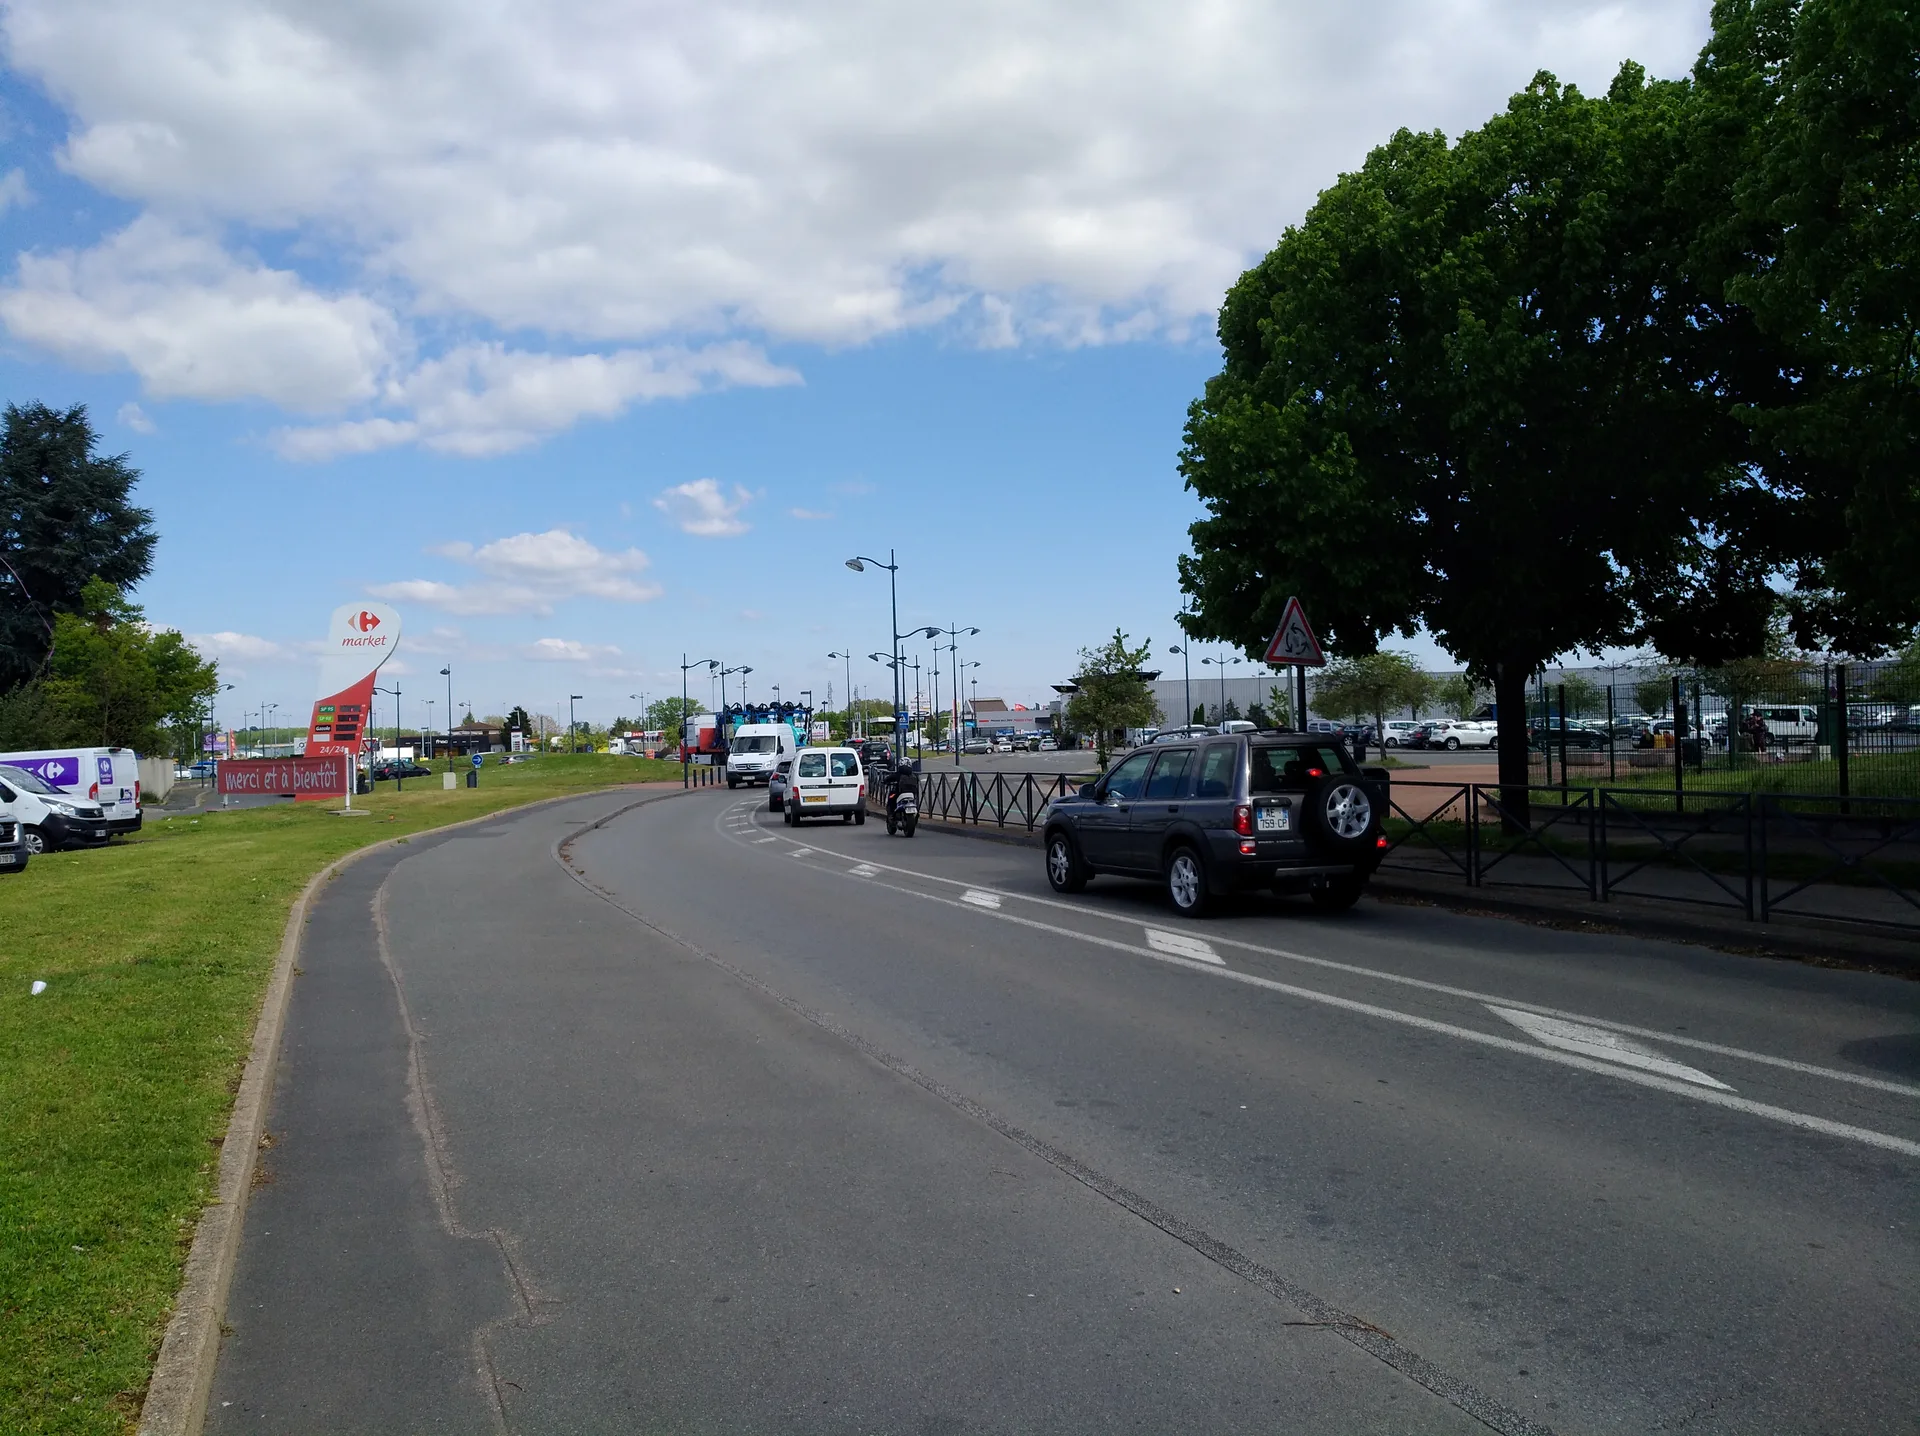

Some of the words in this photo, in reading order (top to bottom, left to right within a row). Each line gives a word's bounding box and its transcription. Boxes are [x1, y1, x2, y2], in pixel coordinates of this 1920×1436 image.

[341, 634, 387, 648] market
[225, 768, 260, 791] merci
[264, 765, 277, 789] et
[281, 765, 289, 788] à
[293, 761, 338, 790] bientôt
[1265, 809, 1275, 818] AE
